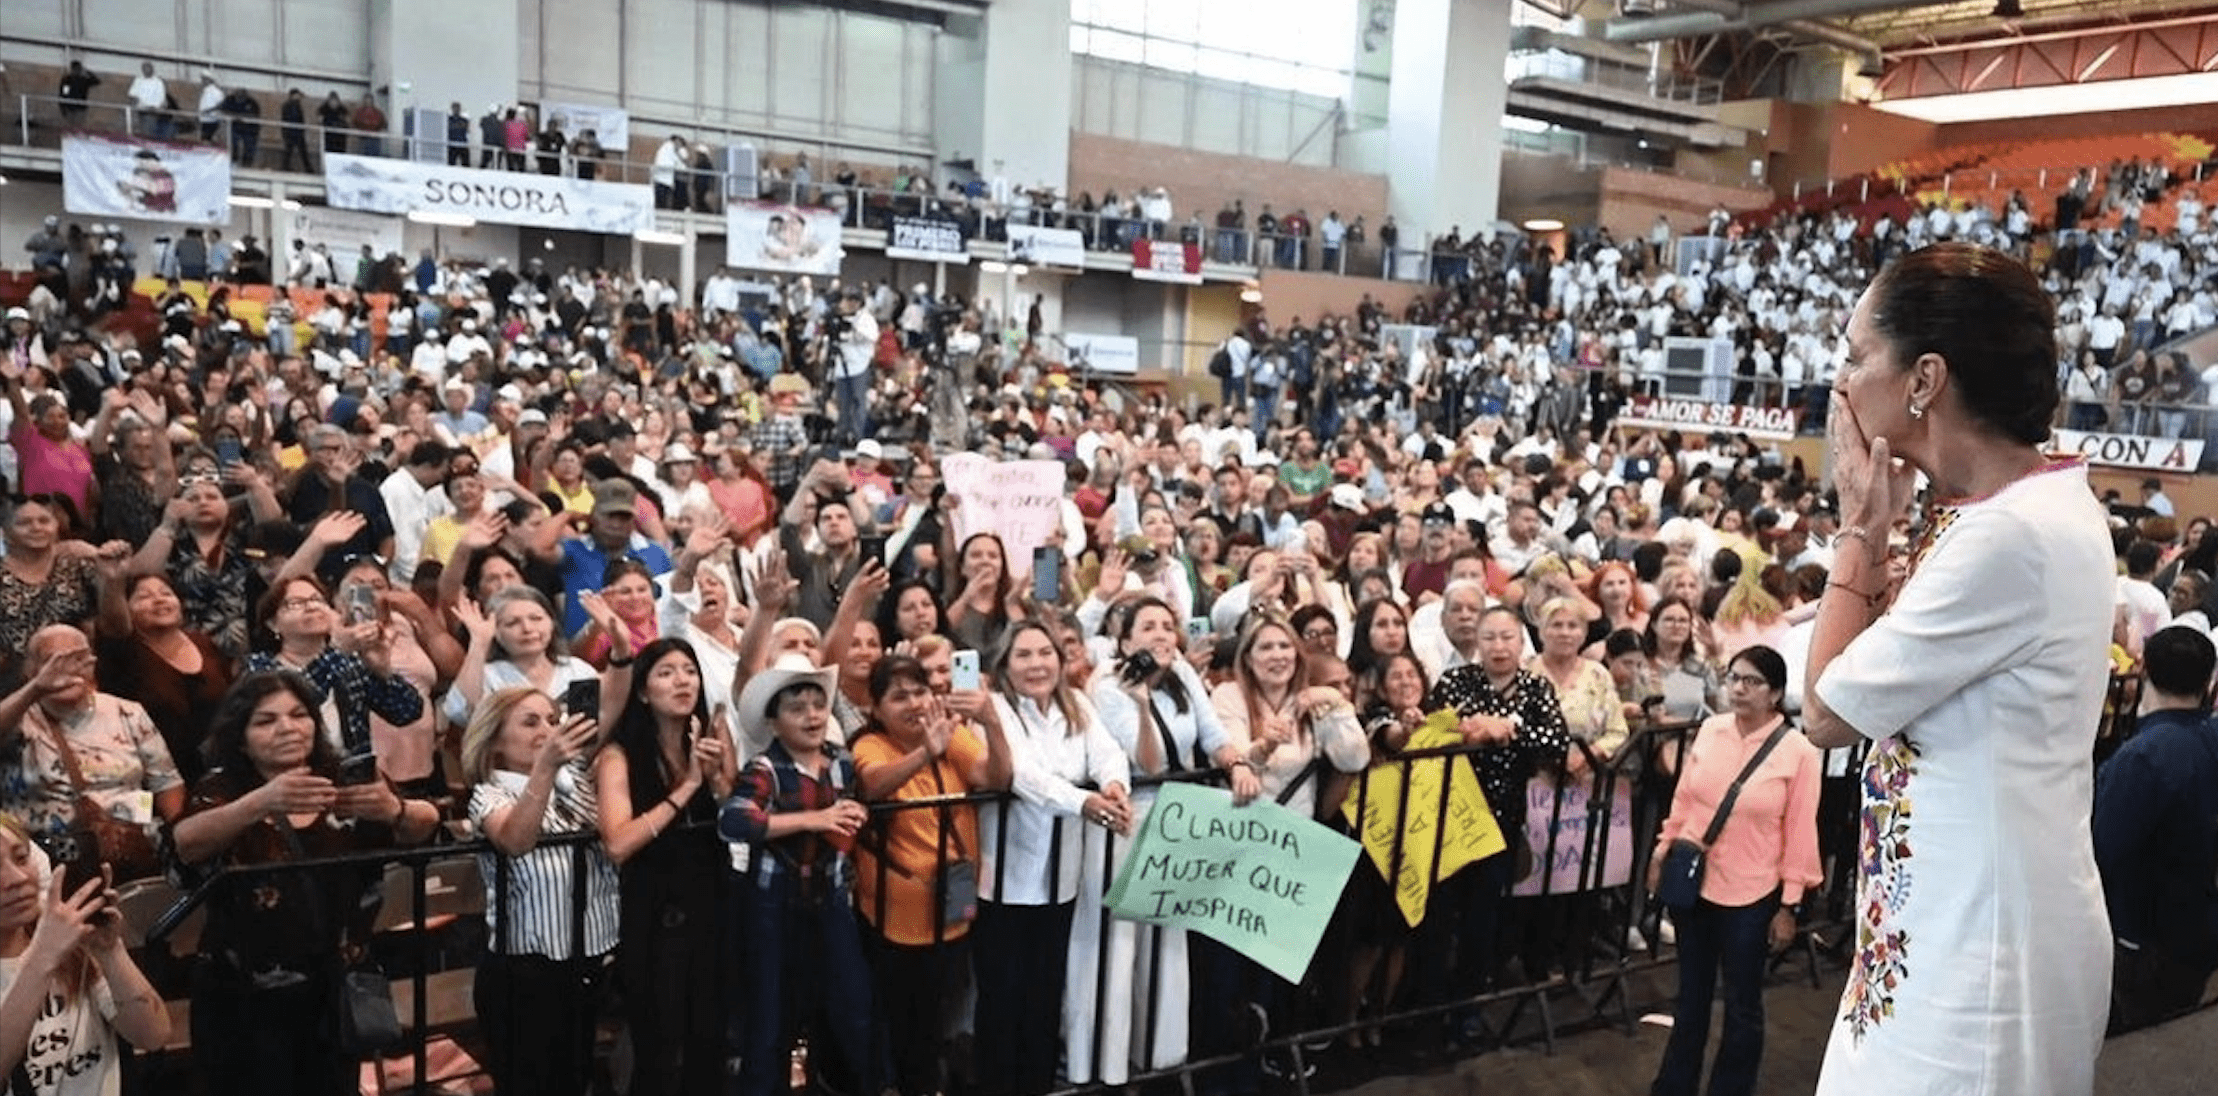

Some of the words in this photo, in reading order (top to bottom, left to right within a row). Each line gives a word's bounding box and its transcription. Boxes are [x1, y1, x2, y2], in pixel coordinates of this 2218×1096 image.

[424, 178, 569, 215] SONORA
[1707, 402, 1735, 426] SE
[1739, 406, 1796, 432] PAGA
[2078, 435, 2150, 463] CON
[1160, 802, 1300, 859] CLAUDIA
[1140, 854, 1237, 883] MUJER
[1249, 865, 1310, 907] QUE
[1145, 890, 1267, 937] INSPIRA
[31, 1027, 70, 1058] es
